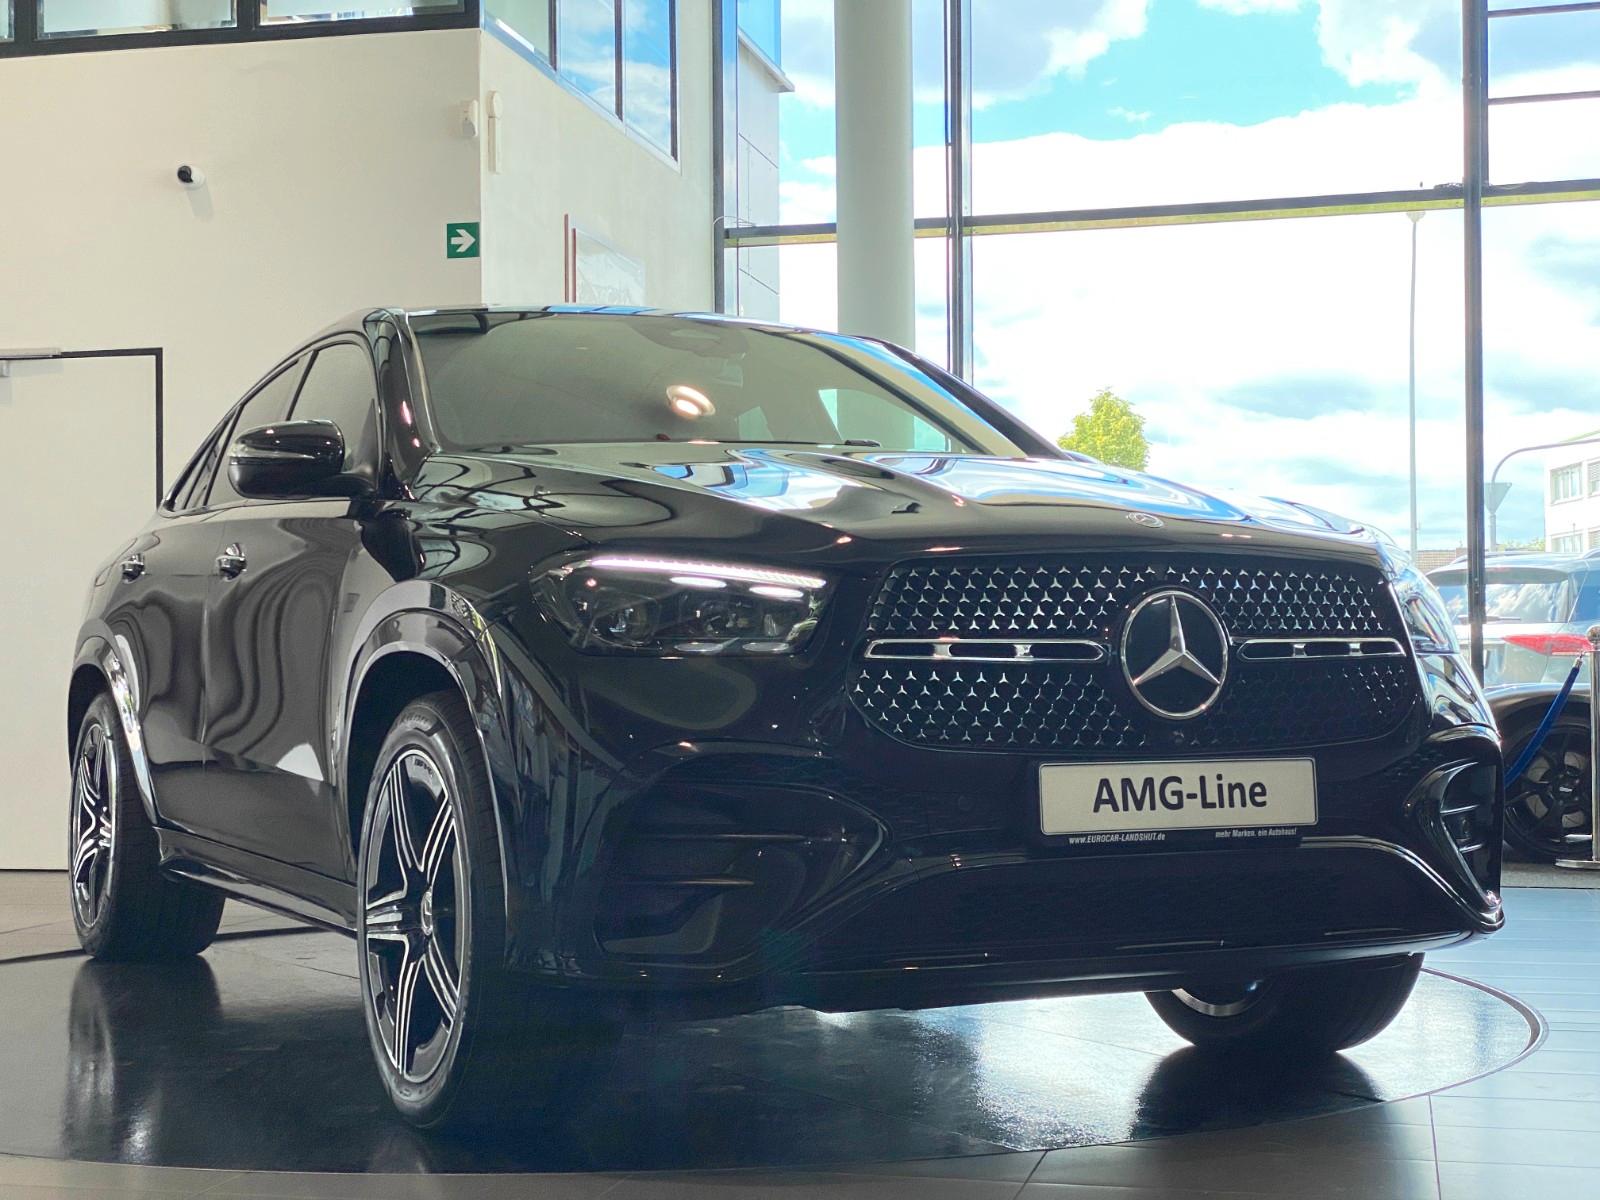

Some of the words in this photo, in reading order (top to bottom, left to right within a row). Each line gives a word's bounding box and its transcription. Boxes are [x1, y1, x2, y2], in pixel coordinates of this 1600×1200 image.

[1093, 774, 1267, 813] AMG-Line
[1069, 832, 1166, 844] www.EUROCAR-LANDSHUT.de
[1215, 829, 1231, 838] mehr
[1258, 829, 1268, 837] ein
